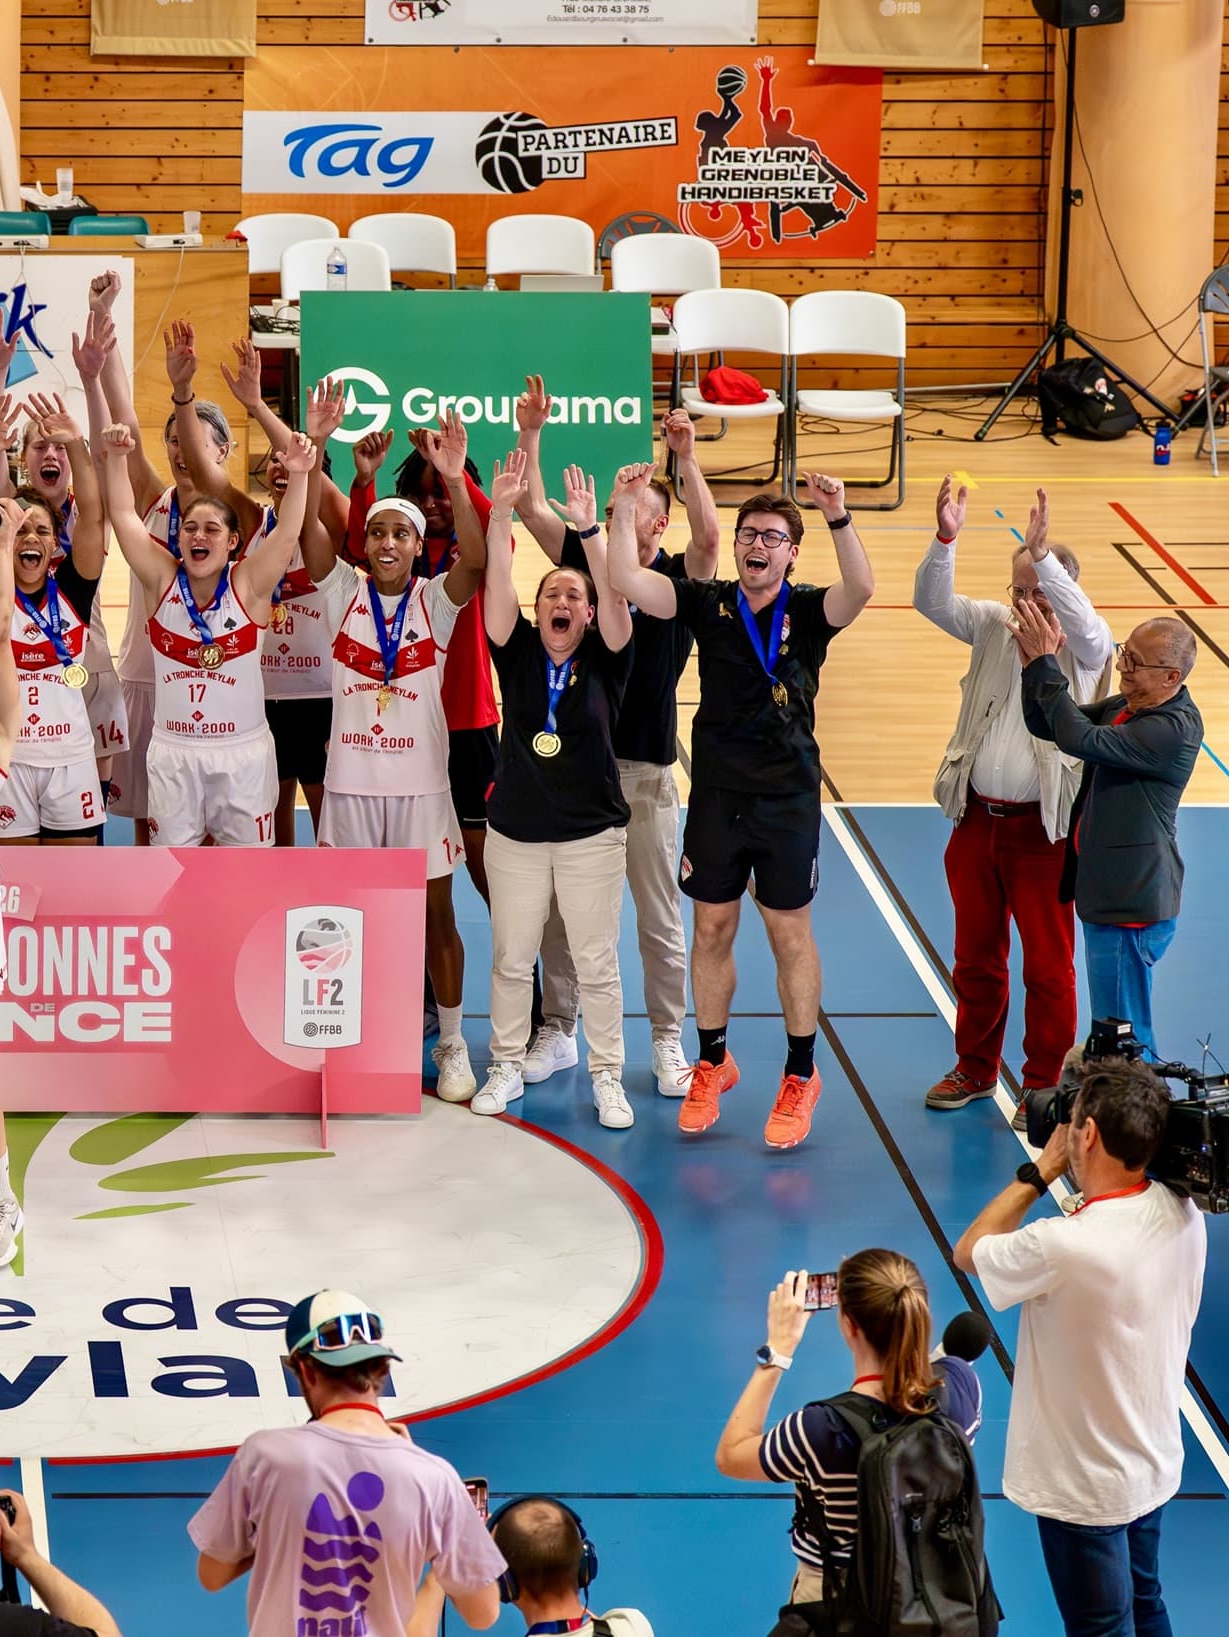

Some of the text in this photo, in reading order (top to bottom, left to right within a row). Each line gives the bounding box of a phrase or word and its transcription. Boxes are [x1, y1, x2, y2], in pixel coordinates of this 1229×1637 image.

[582, 5, 595, 14] 04
[597, 5, 608, 14] 76
[610, 5, 622, 14] 43
[624, 5, 636, 14] 38
[638, 5, 650, 14] 75
[522, 121, 672, 152] PARTENAIRE
[283, 123, 434, 188] Tag
[711, 149, 809, 164] MEYLAN
[547, 156, 579, 174] DU
[701, 168, 818, 182] GRENOBLE
[680, 186, 835, 201] HANDIBASKET
[291, 603, 322, 620] MEYLAN
[22, 651, 45, 660] isère
[260, 655, 321, 668] ORK 2000
[163, 670, 237, 686] LA TRONCHE MEYLAN
[28, 686, 39, 706] 2
[188, 684, 207, 703] 17
[342, 686, 354, 696] LA
[38, 723, 71, 737] 2000
[97, 720, 124, 749] 14
[166, 720, 235, 734] WORK 2000
[341, 732, 414, 748] WORK 2000
[81, 792, 94, 819] 2
[255, 811, 272, 842] 17
[443, 837, 452, 864] 1
[303, 979, 343, 1006] LF2
[30, 1003, 56, 1012] DE
[319, 1025, 342, 1035] FFBB
[102, 1286, 294, 1331] de
